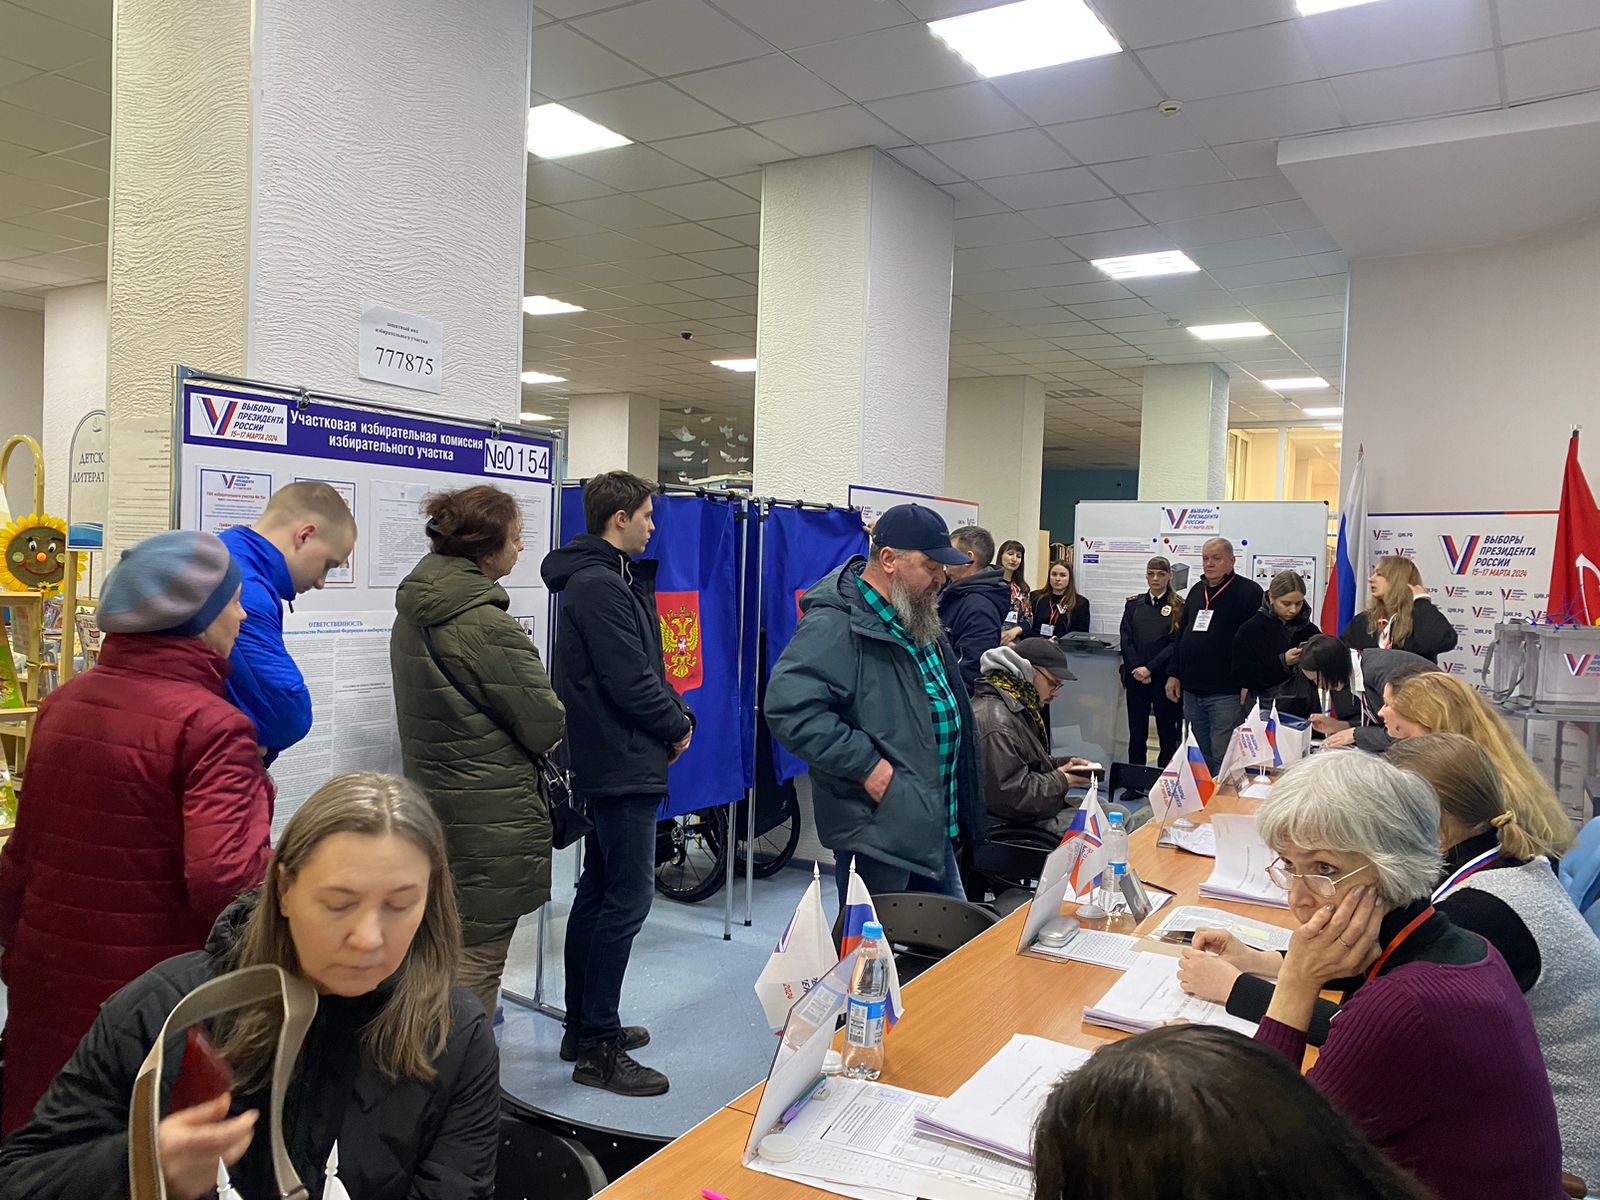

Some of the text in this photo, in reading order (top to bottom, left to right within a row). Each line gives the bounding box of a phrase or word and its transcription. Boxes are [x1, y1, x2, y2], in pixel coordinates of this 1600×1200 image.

[375, 346, 434, 376] 777875
[241, 402, 276, 414] ВЫБОРЫ
[237, 412, 285, 425] ПРЕЗИДЕНТА
[233, 421, 265, 432] РОССИИ
[290, 409, 483, 450] Участковая избирательная комиссия
[246, 432, 264, 441] МАРТА
[329, 434, 454, 461] избирательного участка
[1484, 535, 1525, 544] ВЫБОРЫ
[1479, 546, 1537, 557] ПРЕЗИДЕНТА
[1474, 557, 1511, 567] РОССИИ
[1489, 569, 1511, 577] МАРТА
[1511, 569, 1528, 578] 2024
